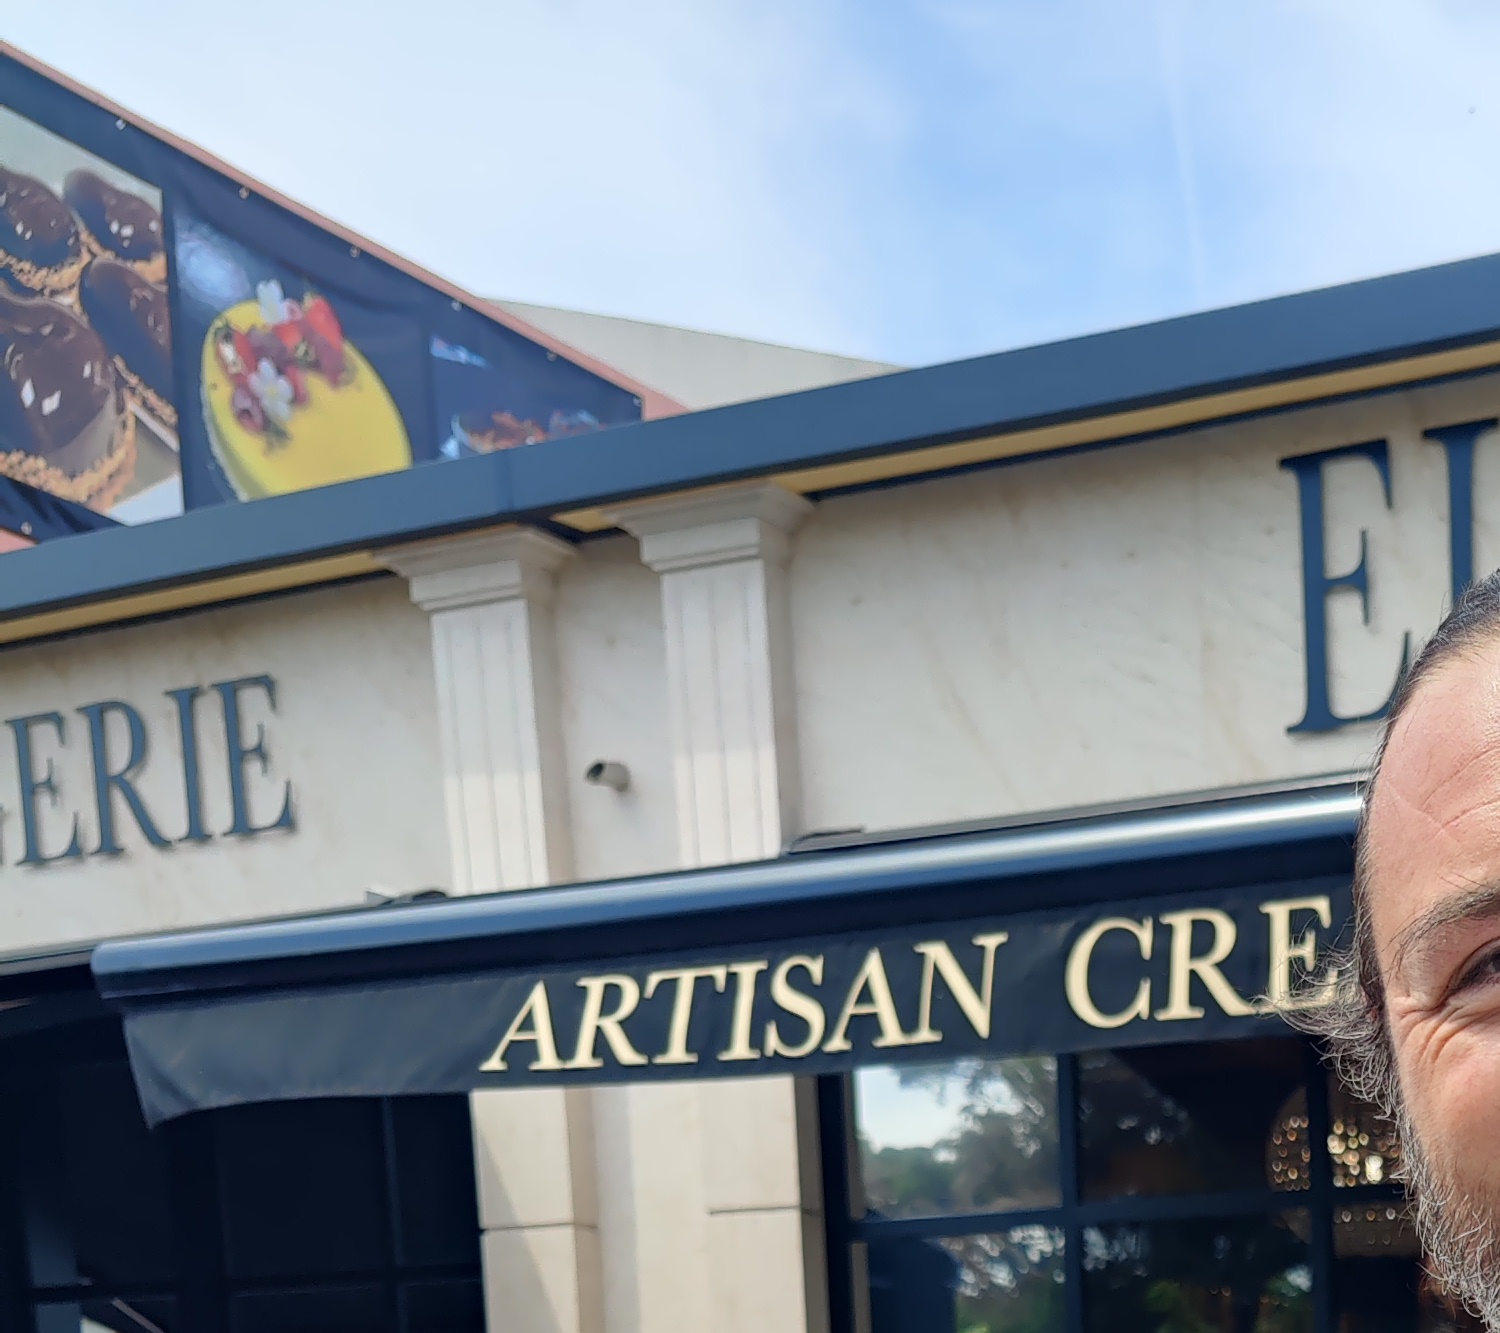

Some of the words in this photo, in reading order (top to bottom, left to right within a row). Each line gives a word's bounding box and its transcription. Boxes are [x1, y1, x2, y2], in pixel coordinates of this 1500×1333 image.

[0, 675, 295, 868] ERIE
[479, 931, 1008, 1073] ARTISAN
[1064, 896, 1338, 1029] CRE
